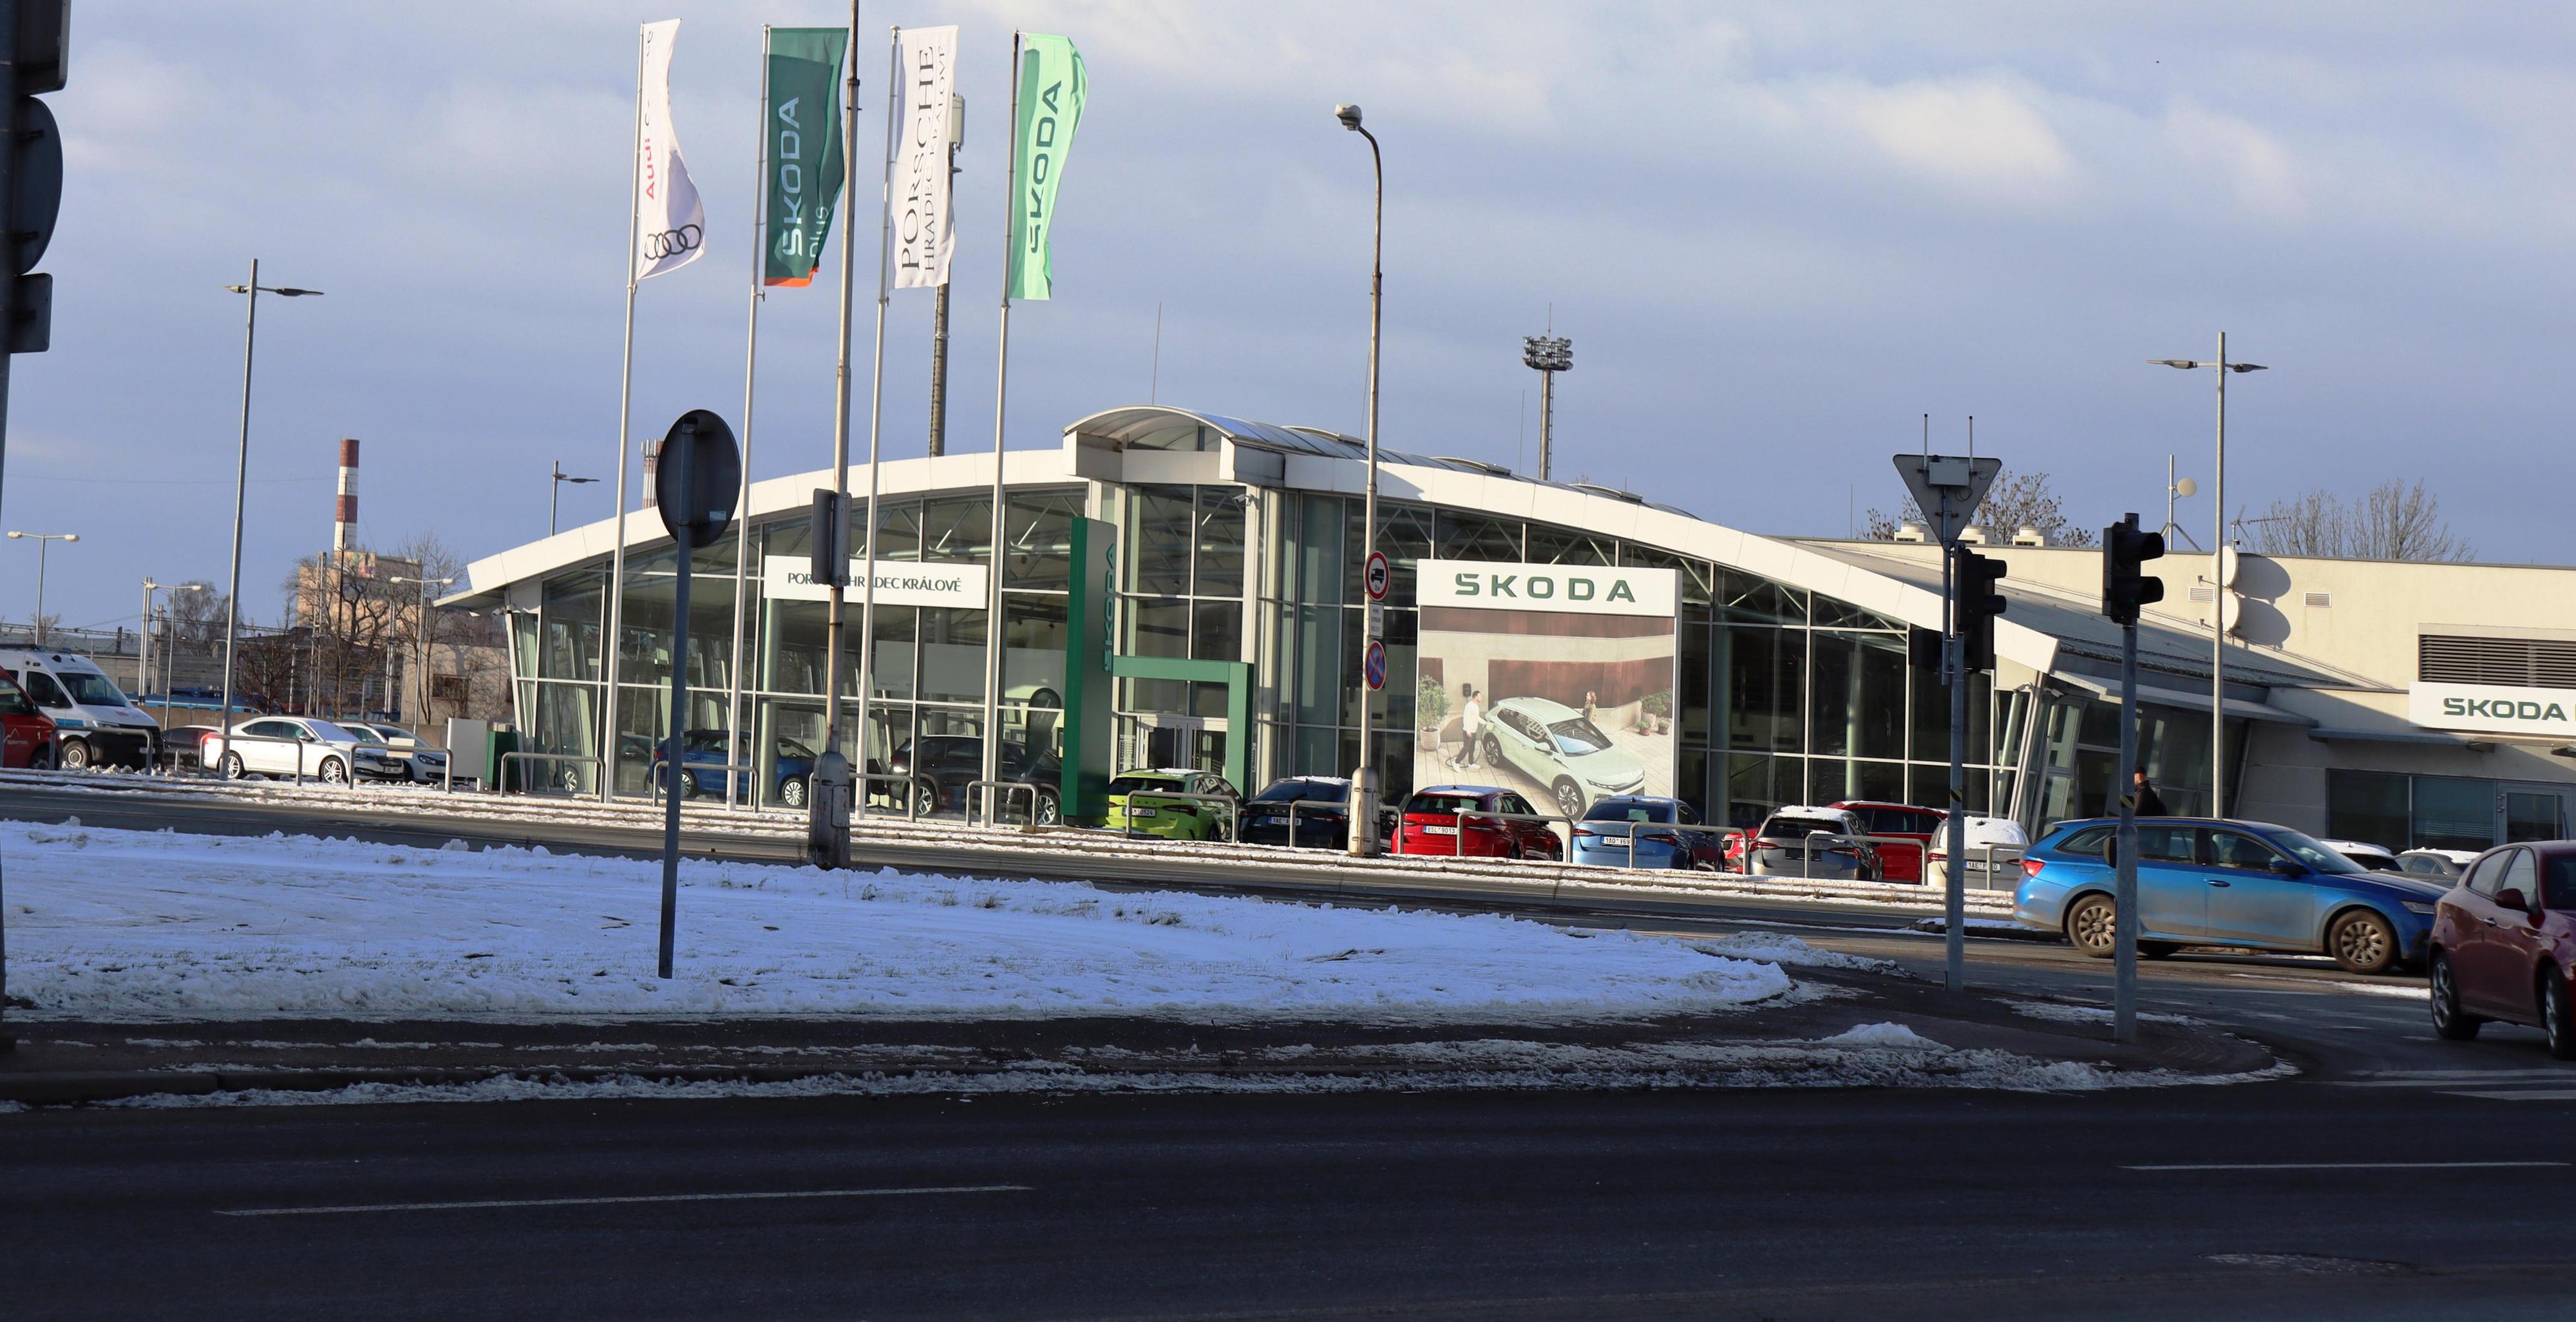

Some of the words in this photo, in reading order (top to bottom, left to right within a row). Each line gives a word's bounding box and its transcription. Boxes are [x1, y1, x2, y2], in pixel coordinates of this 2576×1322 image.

[645, 138, 655, 200] Audi
[902, 46, 934, 272] PORSCHE
[924, 165, 934, 271] HRADEC
[902, 576, 961, 592] KRÁLOVÉ
